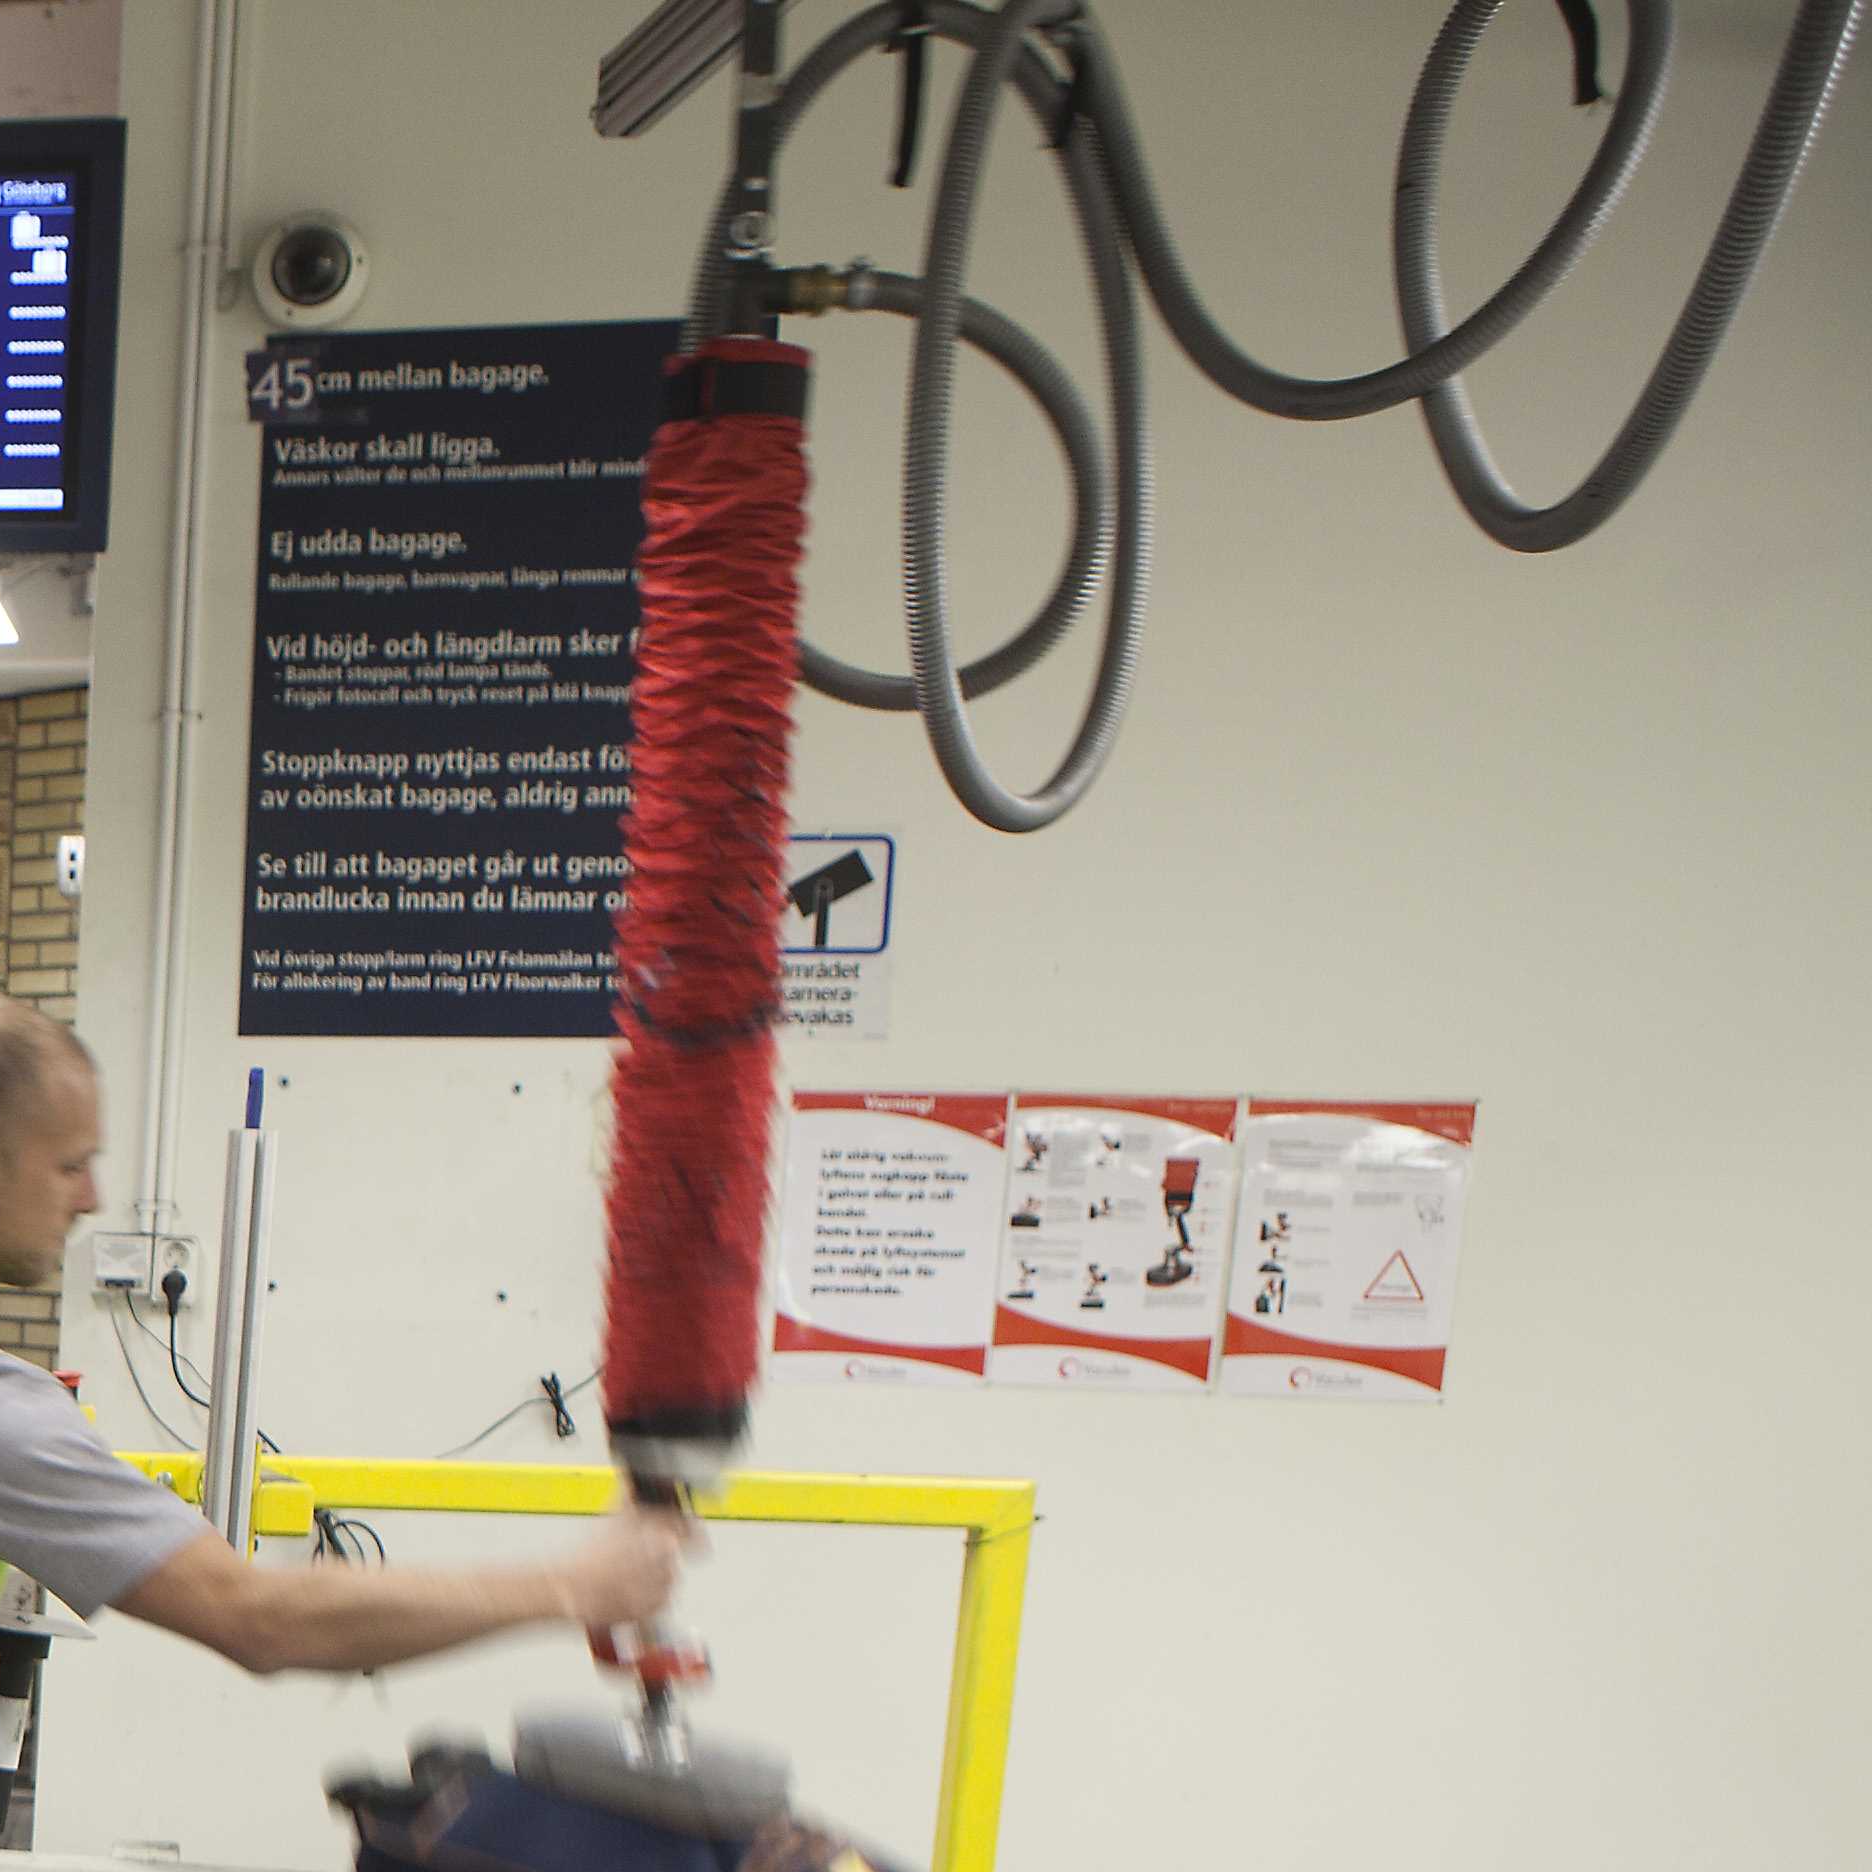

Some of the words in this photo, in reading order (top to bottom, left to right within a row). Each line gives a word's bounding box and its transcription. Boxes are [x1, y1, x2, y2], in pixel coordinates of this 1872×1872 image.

[250, 356, 316, 412] 45
[317, 369, 352, 392] cm
[358, 361, 443, 391] mellan
[450, 359, 550, 395] bagage.
[274, 437, 359, 465] Väskor
[366, 432, 423, 461] skall
[431, 430, 500, 468] ligga.
[385, 465, 408, 483] de
[410, 464, 442, 482] och
[600, 457, 649, 477] mind
[271, 532, 294, 562] Ej
[300, 528, 362, 556] udda
[369, 526, 467, 560] bagage.
[267, 634, 306, 659] Vid
[313, 631, 378, 664] höjd-
[383, 630, 430, 658] och
[435, 628, 562, 664] längdlarm
[568, 627, 619, 656] sker
[403, 685, 433, 705] och
[526, 683, 549, 706] på
[262, 748, 409, 780] Stoppknapp
[415, 746, 501, 779] nyttjas
[507, 745, 590, 773] endast
[260, 787, 290, 810] av
[296, 783, 393, 810] oönskat
[400, 782, 498, 815] bagage,
[504, 779, 578, 814] aldrig
[584, 783, 637, 807] ann
[257, 853, 287, 878] Se
[294, 850, 327, 878] till
[333, 852, 369, 877] att
[376, 850, 478, 884] bagaget
[484, 849, 527, 884] går
[532, 853, 559, 877] ut
[565, 855, 635, 883] geno
[256, 886, 390, 912] brandlucka
[398, 885, 466, 912] innan
[472, 884, 504, 911] du
[510, 884, 599, 911] lämnar
[253, 949, 280, 969] Vid
[780, 960, 860, 979] mrådet
[252, 971, 279, 990] För
